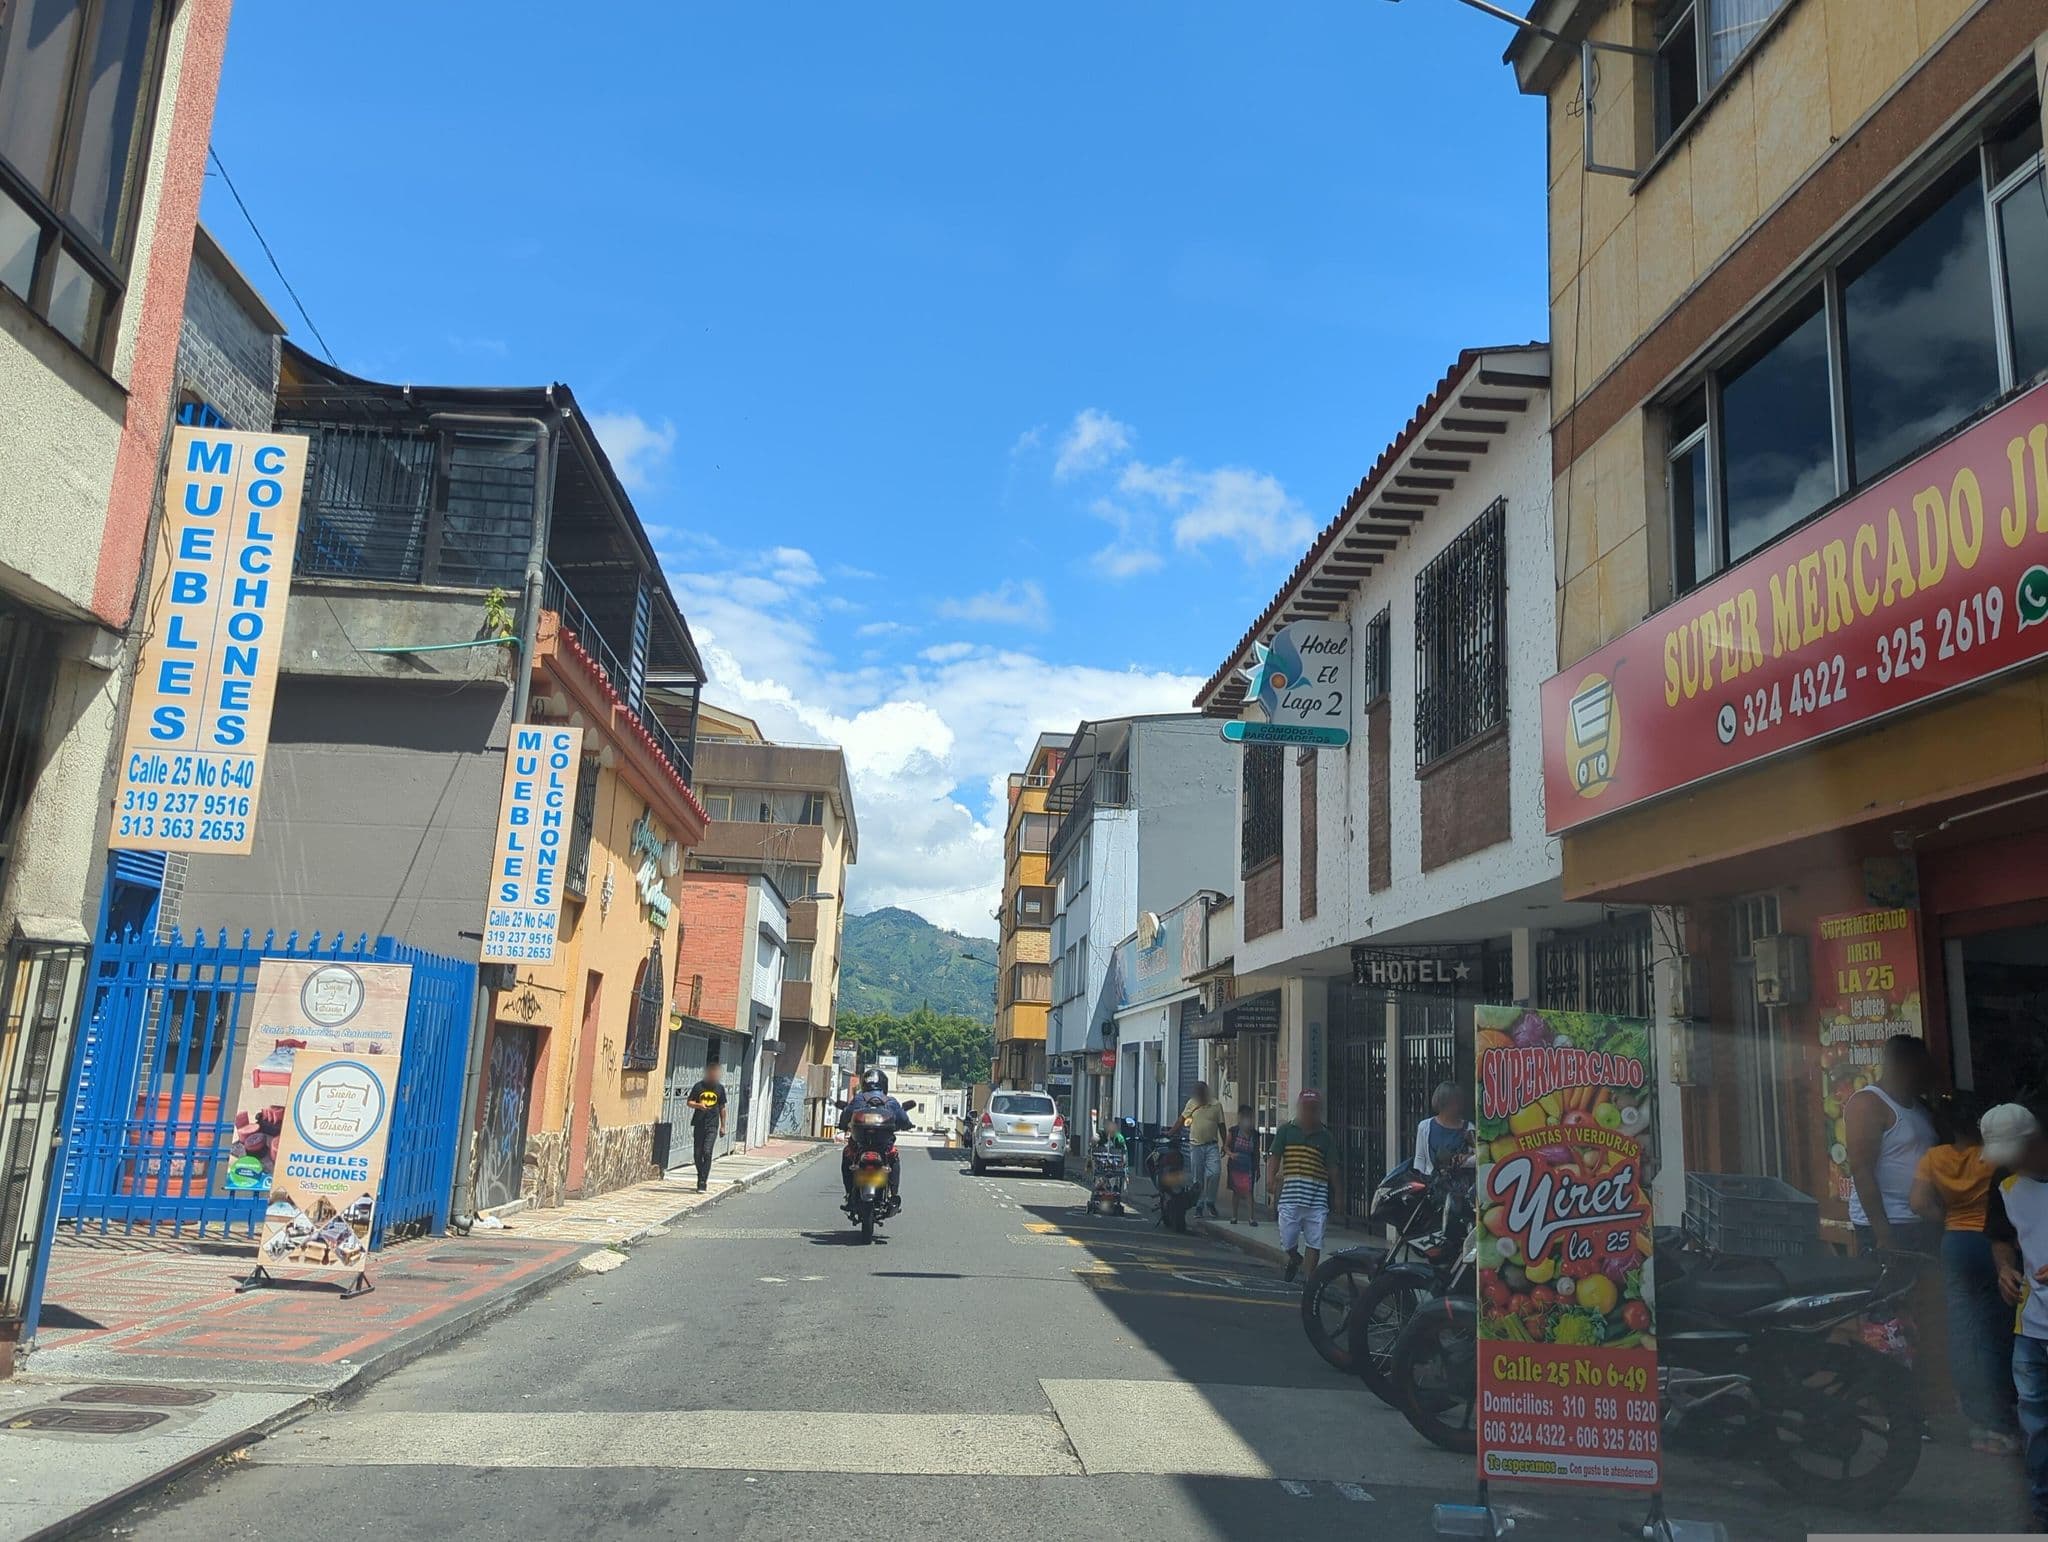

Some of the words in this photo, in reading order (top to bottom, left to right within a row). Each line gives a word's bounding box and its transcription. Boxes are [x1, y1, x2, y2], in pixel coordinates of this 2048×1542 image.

[149, 440, 234, 742] MUEBLES
[213, 446, 288, 746] COLCHONES
[1664, 588, 1763, 707] SUPER
[1770, 467, 1984, 658] MERCADO
[1299, 634, 1348, 655] Hotel
[1317, 666, 1339, 684] El
[1743, 682, 1783, 736] 324
[1789, 654, 1848, 717] 4322
[1876, 618, 1926, 683] 325
[1936, 585, 2004, 661] 2619
[1281, 691, 1322, 719] Lago
[1325, 691, 1343, 716] 2
[128, 754, 168, 785] Calle
[171, 756, 193, 786] 25
[195, 758, 217, 787] No
[220, 759, 254, 789] 6-40
[123, 790, 159, 812] 319
[163, 792, 199, 813] 237
[203, 795, 250, 817] 9516
[500, 731, 541, 903] MUEBLES
[120, 815, 154, 837] 313
[160, 817, 194, 839] 363
[199, 820, 245, 842] 2653
[533, 734, 571, 906] COLCHONES
[489, 910, 510, 927] Calle
[512, 911, 522, 928] 25
[524, 912, 536, 928] No
[538, 913, 555, 929] 6-40
[1820, 908, 1908, 941] SUPERMERCADO
[485, 944, 503, 956] 313
[506, 945, 524, 957] 363
[527, 946, 552, 959] 2653
[487, 930, 505, 942] 319
[508, 931, 526, 943] 237
[529, 933, 553, 945] 9516
[1370, 959, 1451, 984] HOTEL
[1838, 970, 1863, 995] LA
[1865, 965, 1895, 991] 25
[1483, 1048, 1644, 1119] SUPERMERCADO
[1519, 1128, 1562, 1151] FRUTAS
[1565, 1128, 1572, 1140] Y
[1576, 1128, 1639, 1157] VERDURAS
[286, 1165, 368, 1181] COLCHONES
[289, 1153, 369, 1168] MUEBLES
[1569, 1231, 1593, 1260] la
[1606, 1231, 1630, 1251] 25
[1493, 1354, 1542, 1382] Calle
[1547, 1362, 1570, 1387] 25
[1575, 1359, 1602, 1387] No
[1607, 1363, 1648, 1393] 6-49
[1483, 1390, 1553, 1417] Domicilios:
[1563, 1395, 1586, 1418] 310
[1595, 1397, 1618, 1420] 598
[1626, 1400, 1657, 1423] 0520
[1484, 1420, 1506, 1443] 606
[1510, 1422, 1532, 1444] 324
[1536, 1424, 1566, 1446] 4322
[1576, 1426, 1599, 1449] 606
[1602, 1428, 1625, 1450] 325
[1628, 1430, 1657, 1452] 2619
[1487, 1454, 1500, 1470] Te
[1501, 1458, 1557, 1474] esperamos
[1569, 1463, 1582, 1473] Con
[1583, 1464, 1600, 1477] gusto
[1602, 1467, 1610, 1476] te
